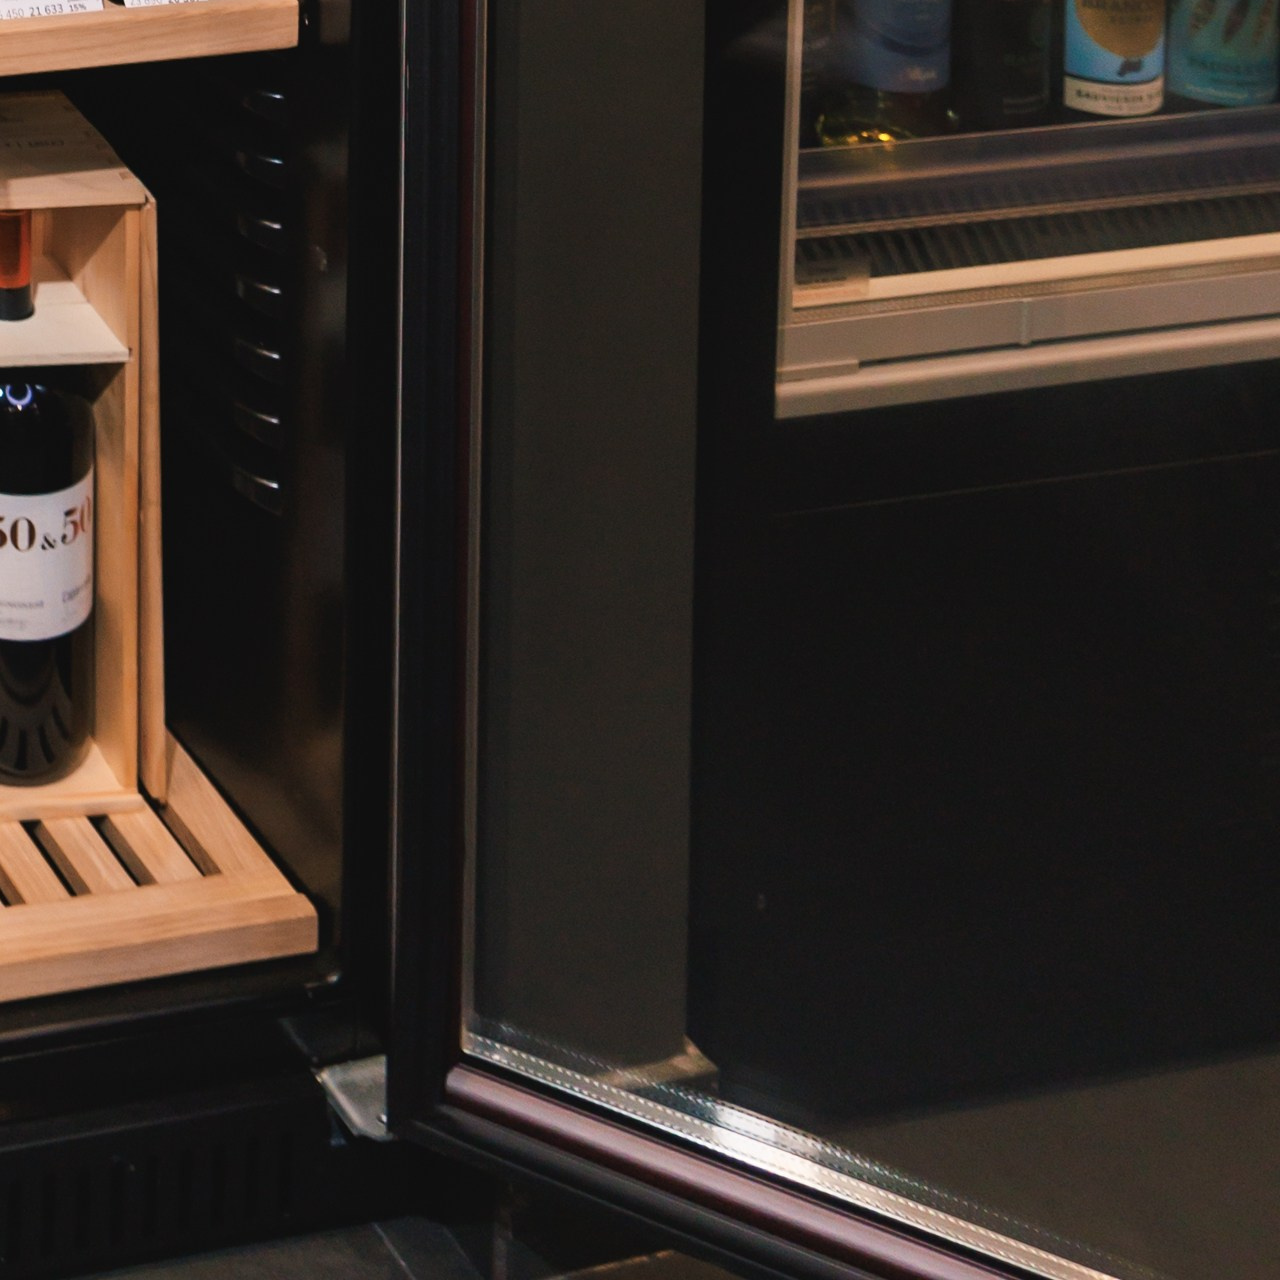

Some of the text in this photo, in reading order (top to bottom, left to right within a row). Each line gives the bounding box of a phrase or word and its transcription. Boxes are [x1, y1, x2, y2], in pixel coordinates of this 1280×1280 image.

[29, 6, 42, 17] 21
[44, 3, 64, 15] 633
[40, 531, 58, 551] &
